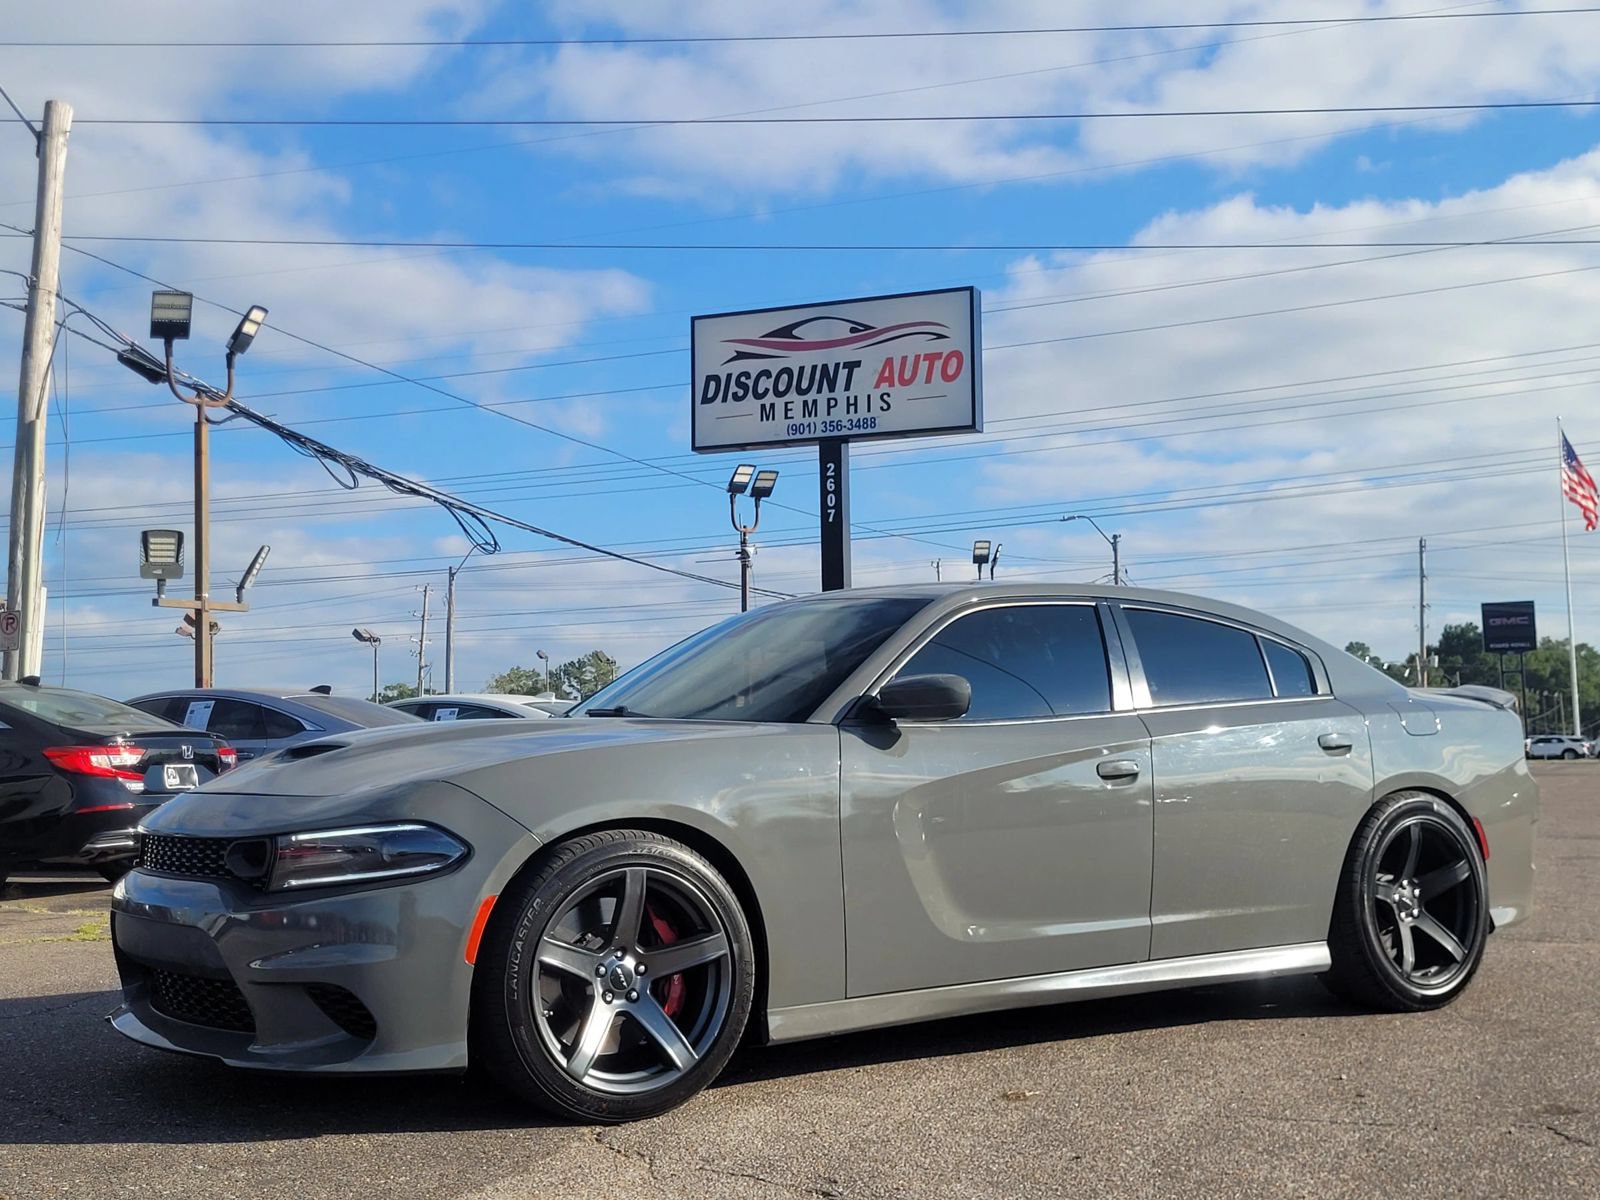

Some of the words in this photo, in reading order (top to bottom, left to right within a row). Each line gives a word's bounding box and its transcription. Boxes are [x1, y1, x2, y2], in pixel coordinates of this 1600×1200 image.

[700, 360, 862, 405] DISCOUNT
[873, 350, 964, 390] AUTO
[759, 392, 892, 422] MEMPHIS
[786, 421, 817, 437] (901)
[821, 416, 877, 434] 356-3488
[826, 462, 836, 522] 2607
[1489, 616, 1529, 626] GMC
